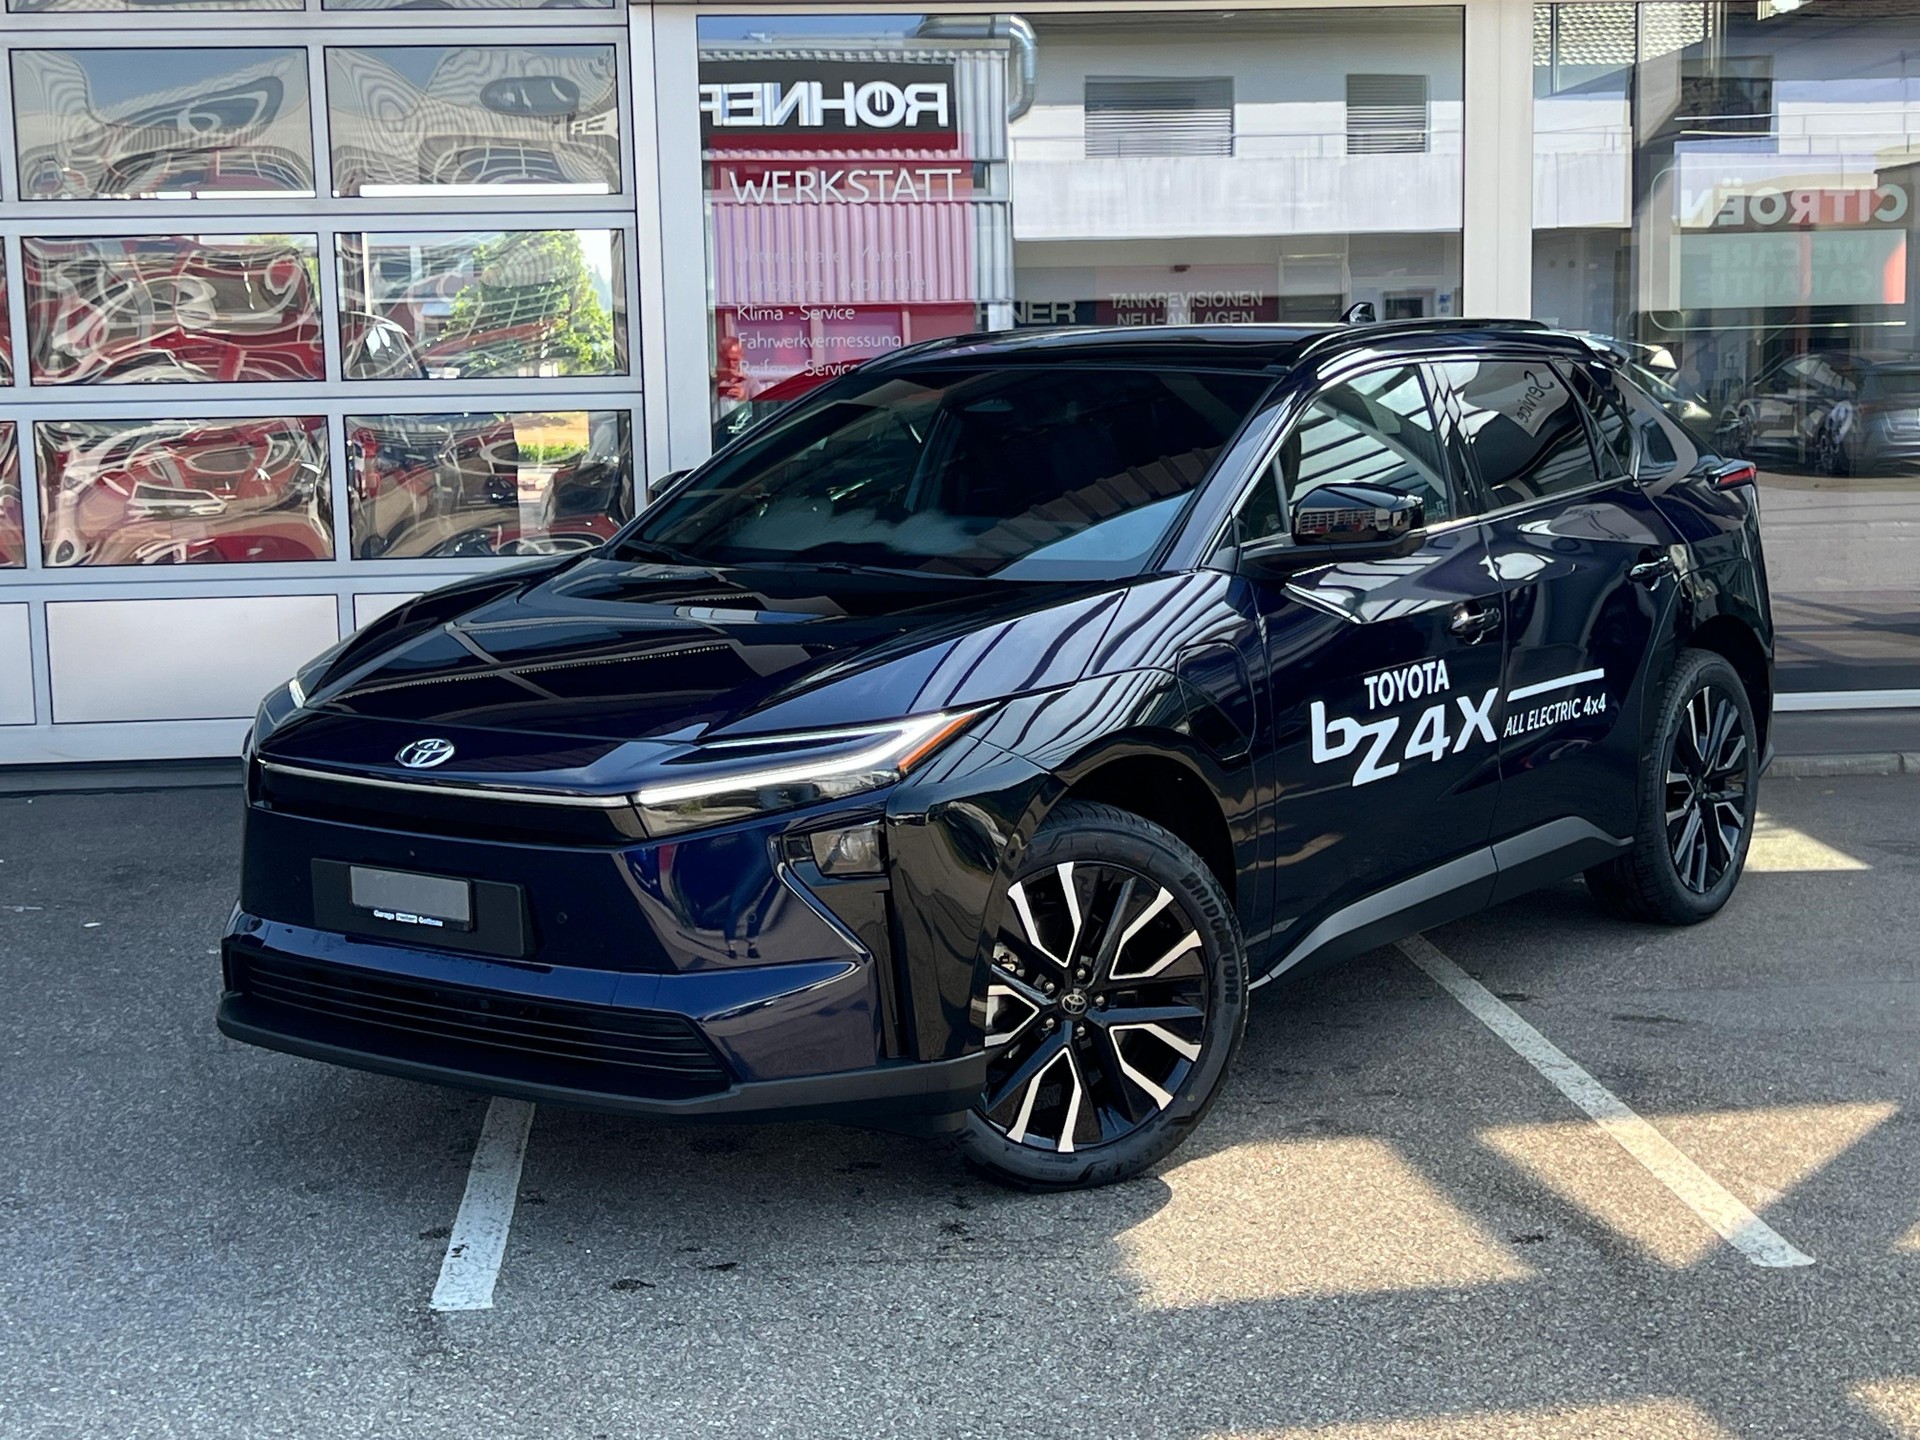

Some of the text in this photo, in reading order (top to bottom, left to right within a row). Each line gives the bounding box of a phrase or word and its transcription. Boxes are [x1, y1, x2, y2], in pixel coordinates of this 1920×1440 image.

[729, 168, 962, 204] WERKSTATT
[737, 304, 783, 321] Klima
[800, 303, 855, 320] Service
[1109, 291, 1263, 309] TANKREVISIONEN
[738, 331, 902, 349] Fahrwerkvermessung
[1364, 659, 1450, 710] TOYOTA
[1503, 692, 1606, 738] ALL ELECTRIC 4x4
